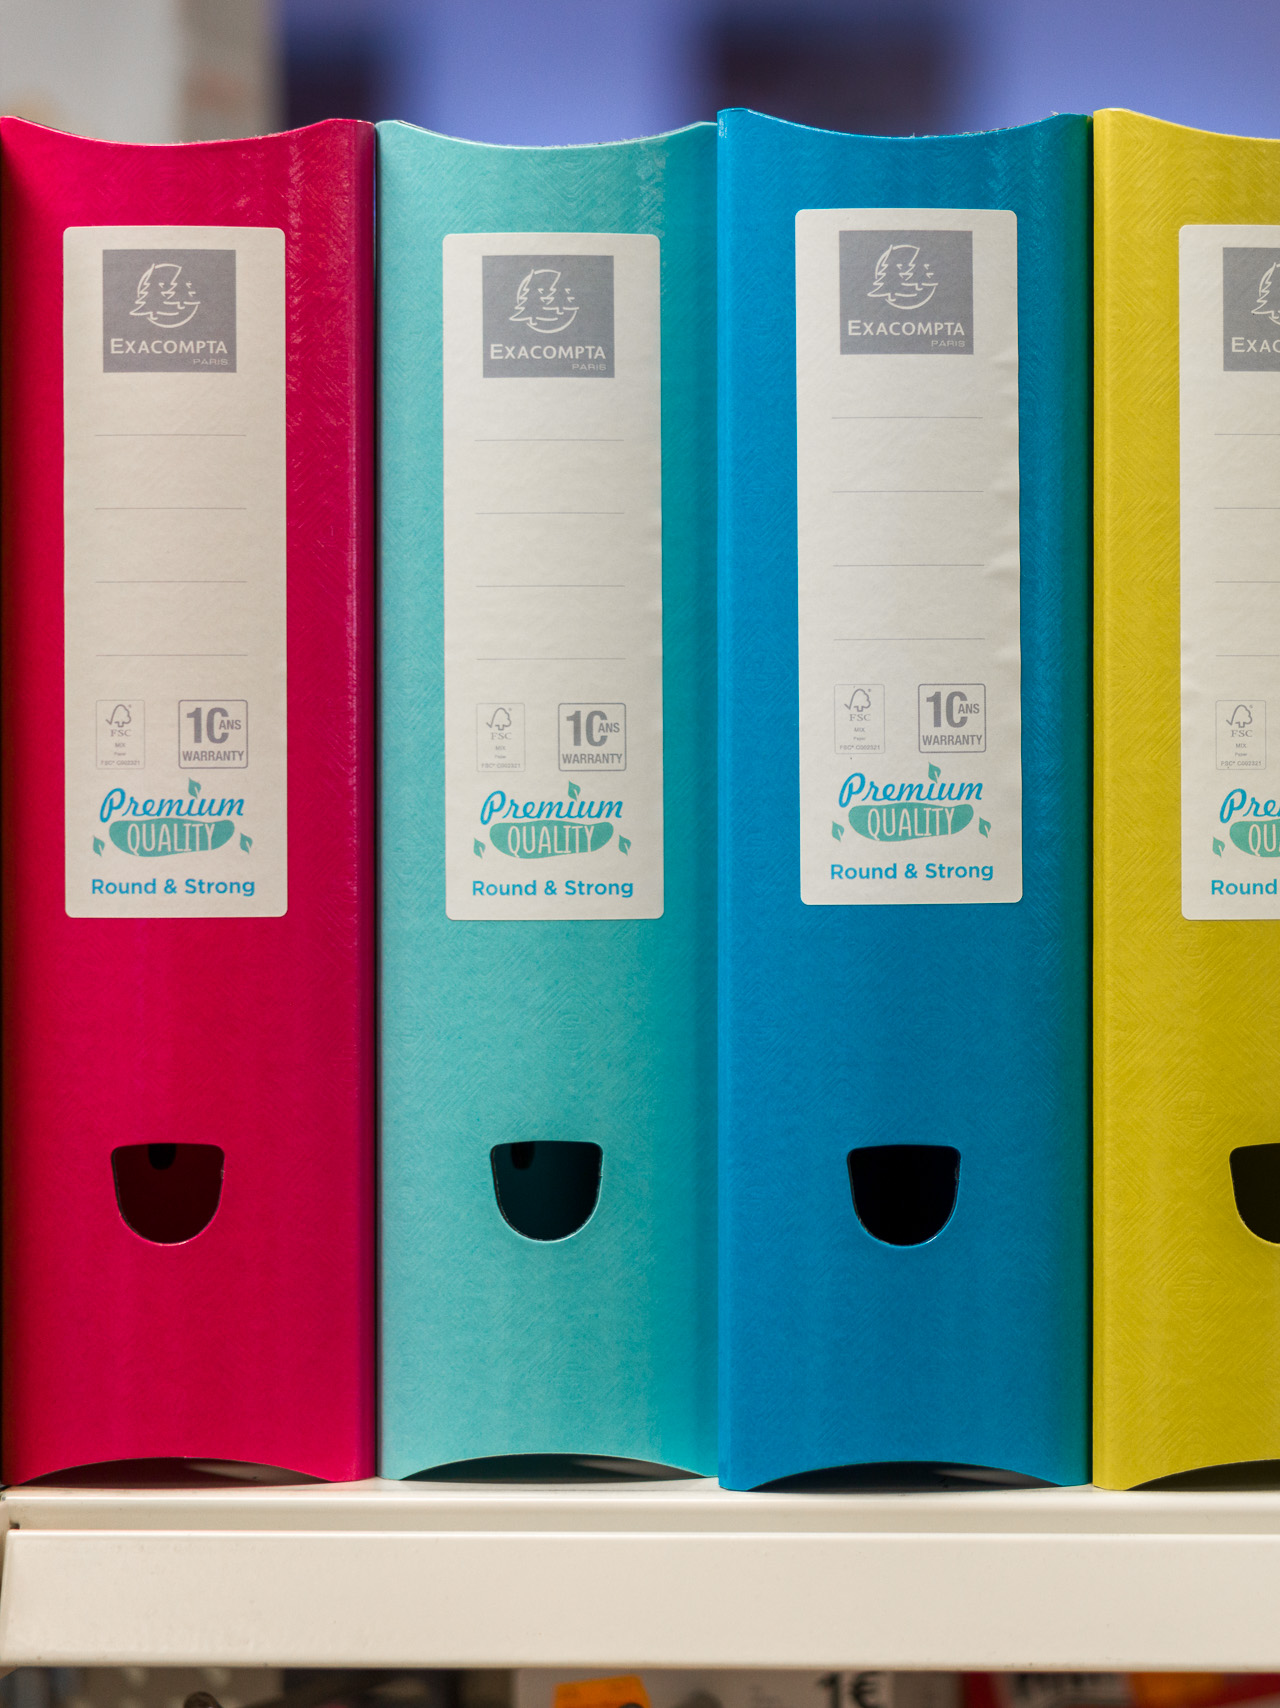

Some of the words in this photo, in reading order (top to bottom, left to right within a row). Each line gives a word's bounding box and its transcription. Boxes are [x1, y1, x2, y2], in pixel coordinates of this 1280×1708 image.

[848, 320, 965, 336] EXACOMPTA
[111, 338, 228, 354] EXACOMPTA
[490, 344, 606, 359] EXACOMPTA
[193, 358, 228, 366] PARIS
[958, 704, 979, 713] ANS
[110, 729, 132, 737] FSC
[219, 720, 241, 730] ANS
[598, 723, 620, 732] ANS
[491, 732, 512, 740] FSC
[923, 735, 982, 745] WARRANTY
[183, 751, 244, 761] WARRANTY
[562, 754, 622, 764] WARRANTY
[839, 773, 983, 808] Premium
[100, 788, 244, 822] Premium
[480, 790, 623, 825] Premium
[868, 808, 954, 841] QUALITY
[127, 824, 215, 856] QUALITY
[508, 826, 594, 858] QUALITY
[831, 863, 897, 879] Round
[905, 864, 917, 878] &
[925, 863, 993, 880] Strong
[92, 878, 156, 894] Round
[164, 879, 177, 894] &
[185, 878, 255, 896] Strong
[473, 880, 536, 895] Round
[544, 881, 557, 895] &
[565, 880, 633, 898] Strong
[1211, 879, 1277, 895] Round
